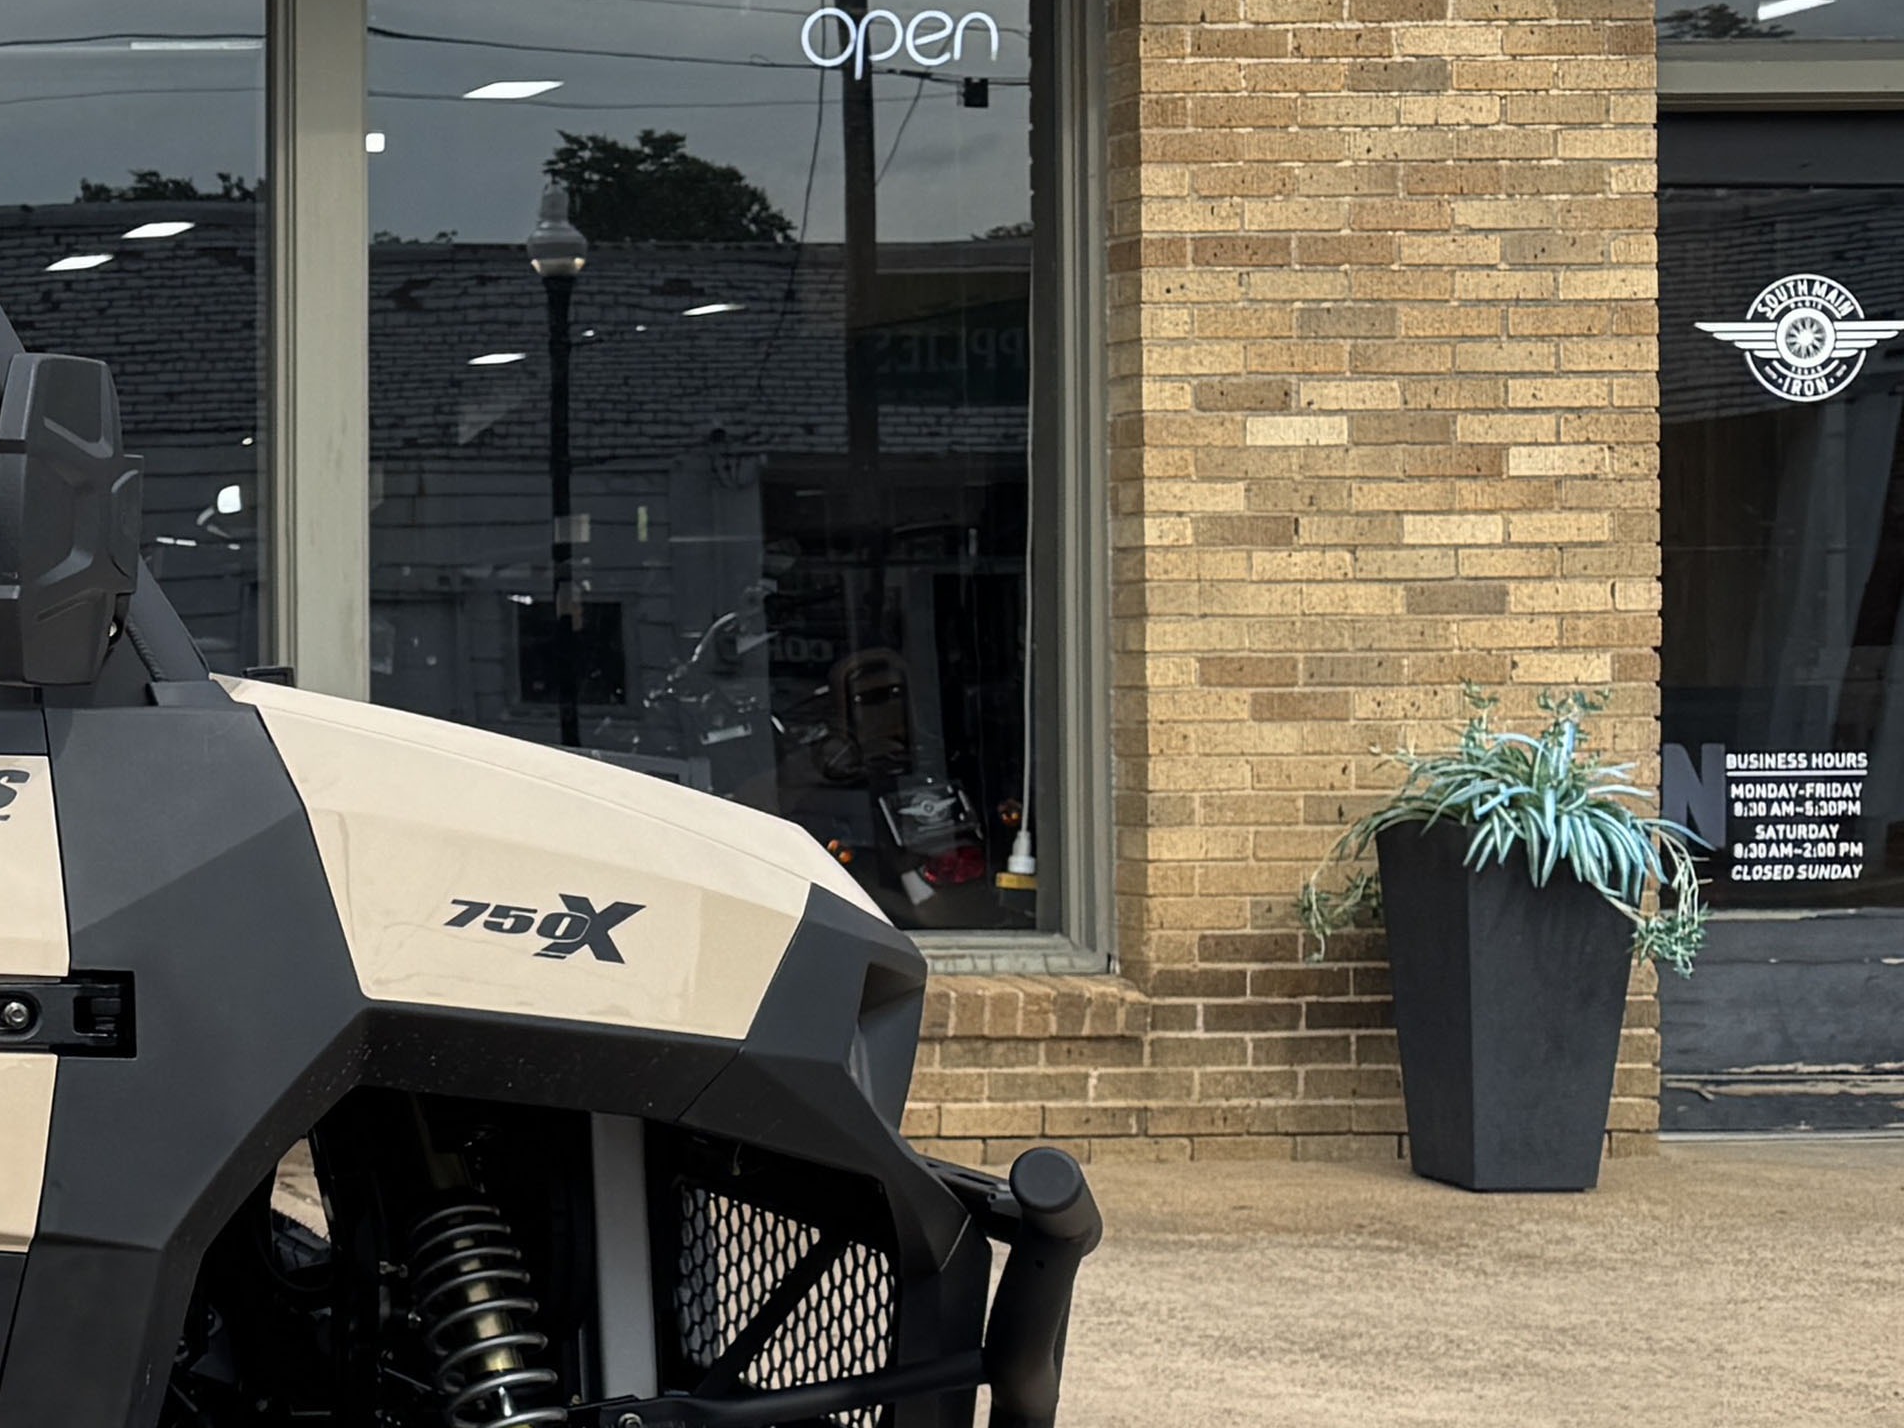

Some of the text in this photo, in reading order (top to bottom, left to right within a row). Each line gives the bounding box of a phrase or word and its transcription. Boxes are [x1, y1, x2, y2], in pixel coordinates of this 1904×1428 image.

[801, 7, 1000, 81] open
[1757, 279, 1855, 318] SOUTH MAIN
[1781, 376, 1830, 397] IRON
[1726, 752, 1869, 769] BUSINESS HOURS
[1730, 782, 1864, 799] MONDAY-FRIDAY
[1734, 802, 1768, 818] 8:30
[1755, 824, 1841, 840] SATURDAY
[1839, 842, 1865, 858] PM
[1731, 864, 1864, 882] CLOSED SUNDAY
[443, 893, 648, 965] 750X
